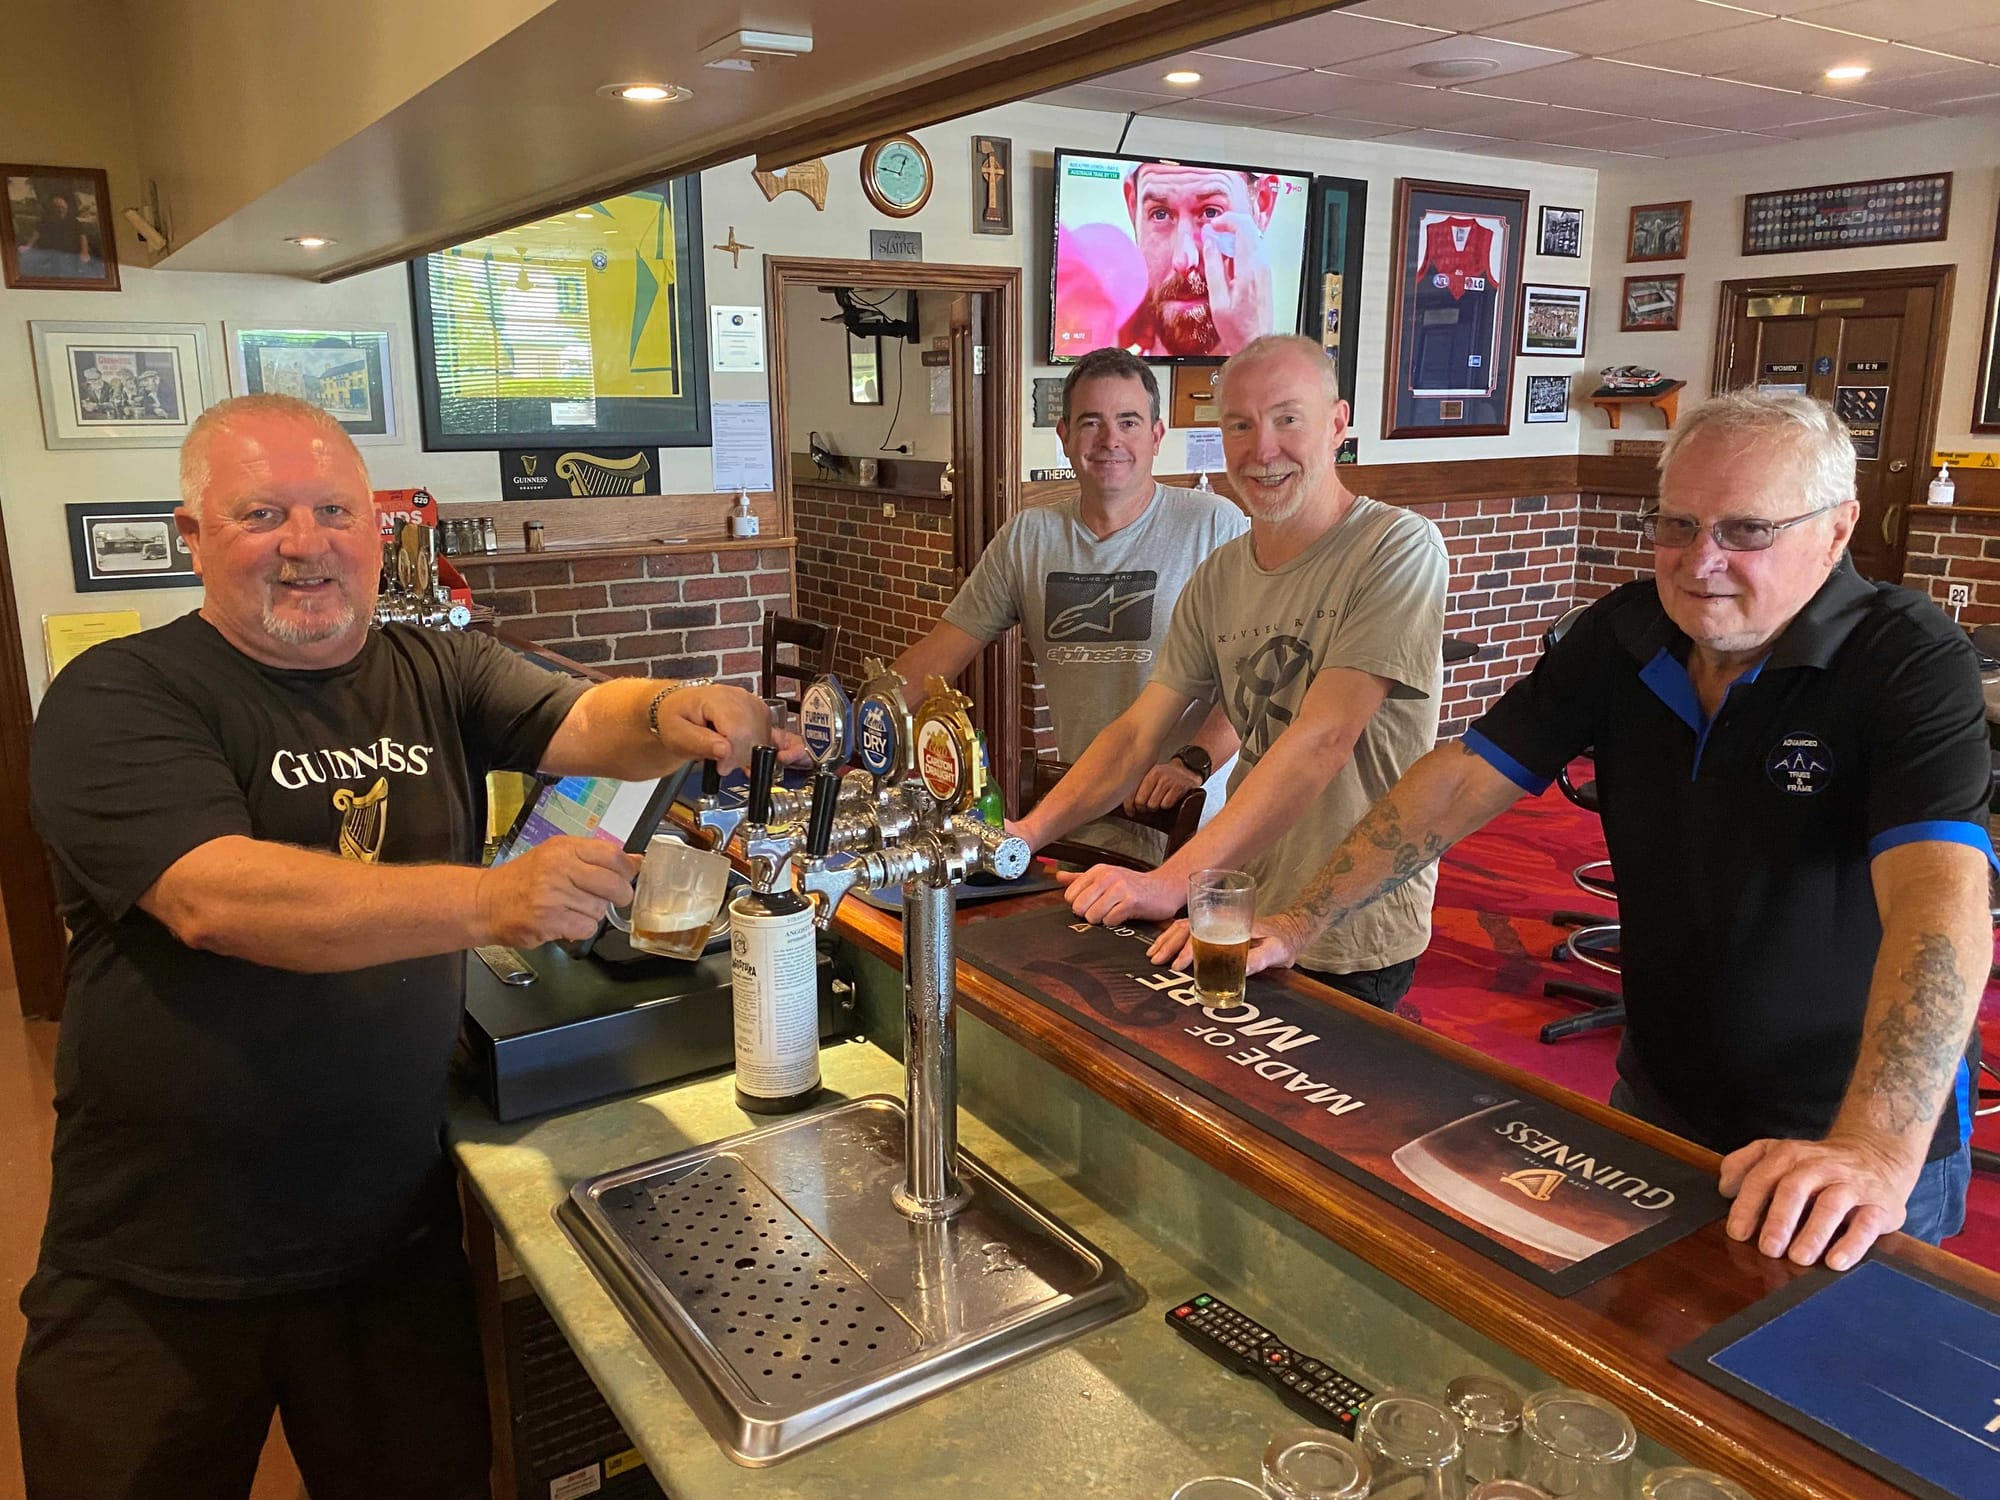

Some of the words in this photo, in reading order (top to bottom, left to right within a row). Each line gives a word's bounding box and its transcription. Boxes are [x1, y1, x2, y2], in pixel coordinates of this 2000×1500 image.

[513, 476, 548, 484] GUINNESS
[413, 494, 429, 505] $20
[1952, 588, 1966, 603] 22
[1217, 622, 1280, 643] XVIE
[1294, 608, 1338, 628] RDD
[805, 710, 829, 726] FURPHY
[806, 728, 830, 742] ORIGINAL
[863, 731, 887, 754] DRY
[1783, 739, 1818, 747] ADVANCED
[925, 755, 954, 771] CARLTON
[924, 765, 956, 783] DRAUGHT
[1788, 771, 1811, 779] TRUSS
[1787, 784, 1813, 792] FRAME
[1183, 1025, 1237, 1048] OF
[1225, 1047, 1367, 1117] MADE
[1495, 1120, 1677, 1210] GUINNESS
